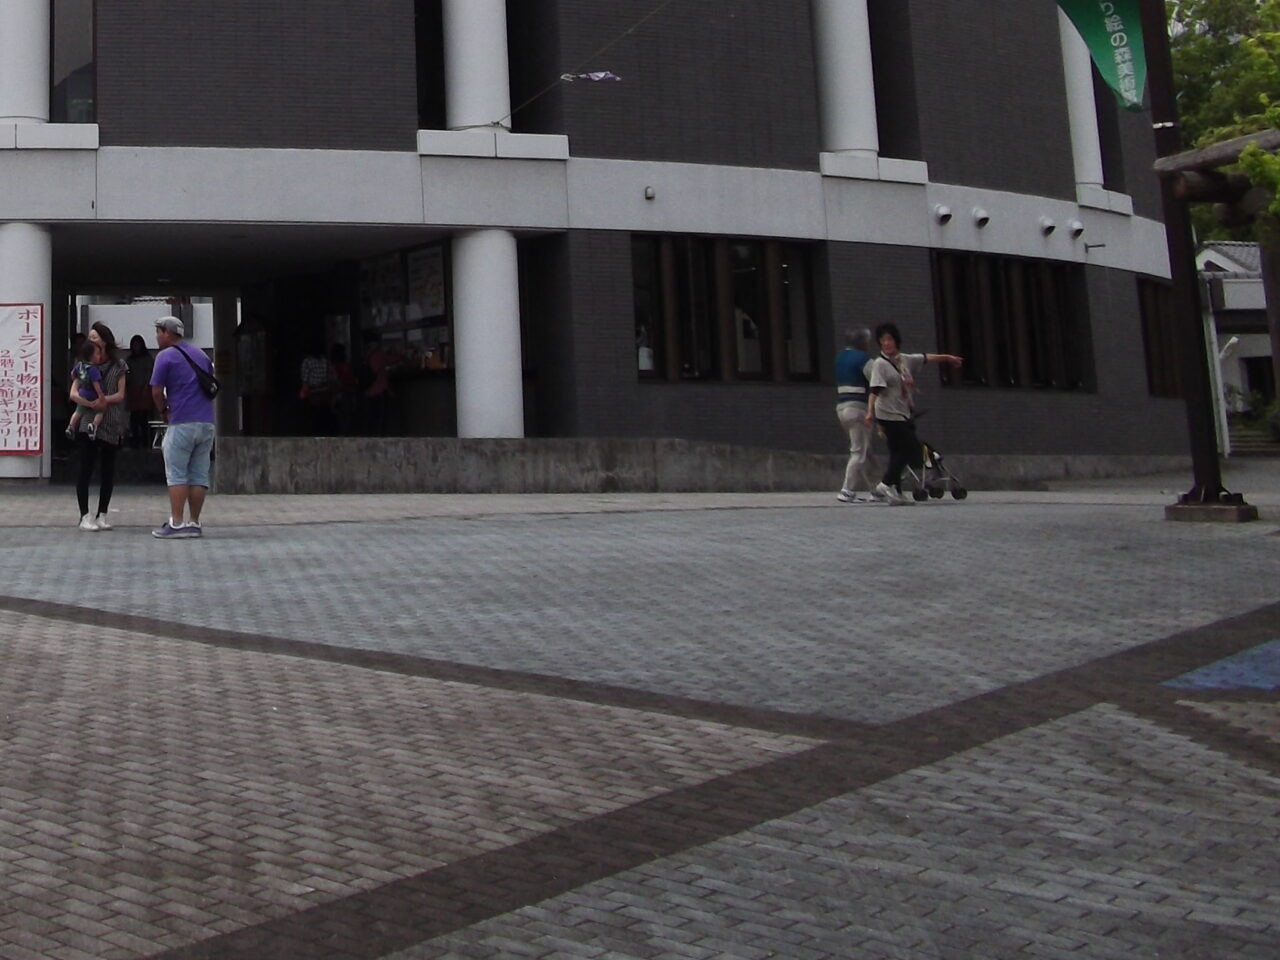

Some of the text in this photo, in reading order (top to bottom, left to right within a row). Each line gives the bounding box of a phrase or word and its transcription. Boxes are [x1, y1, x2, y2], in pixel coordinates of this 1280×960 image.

[17, 309, 38, 450] ポーランド物産展開催中
